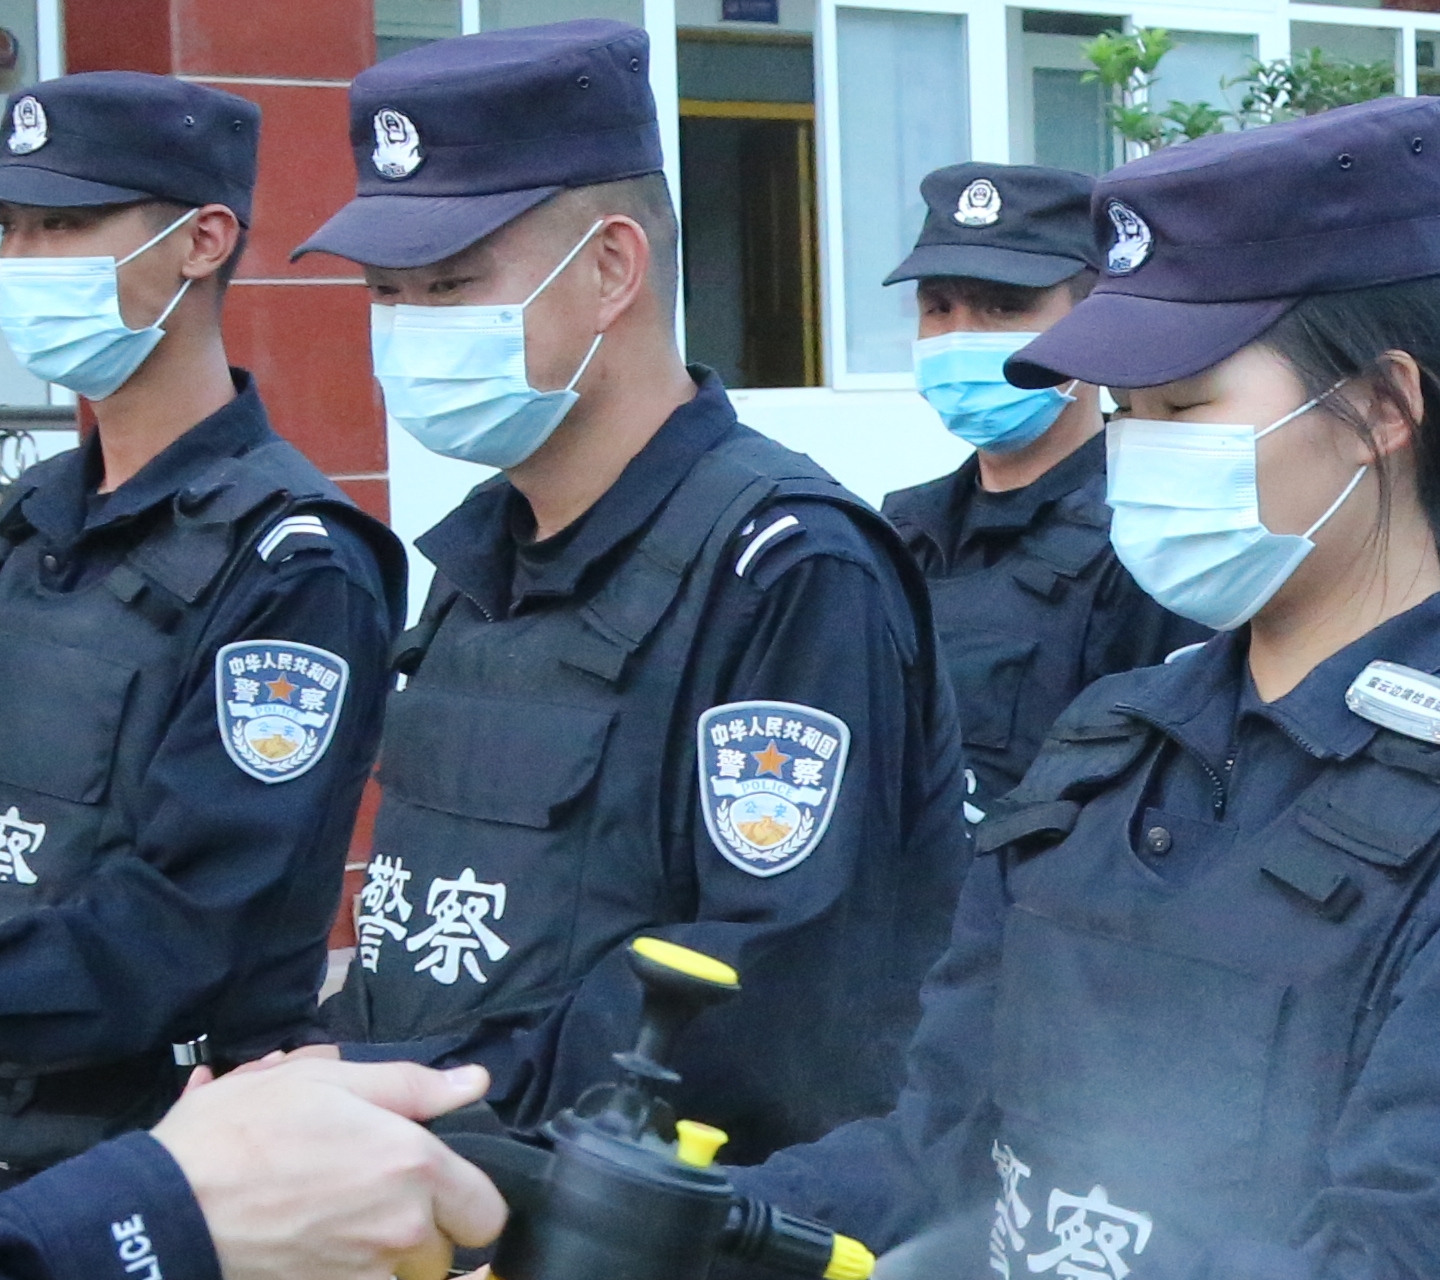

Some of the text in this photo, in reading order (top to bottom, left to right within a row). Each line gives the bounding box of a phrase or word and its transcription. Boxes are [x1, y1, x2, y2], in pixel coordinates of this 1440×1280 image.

[228, 651, 340, 691] 中华人民共和国
[710, 716, 839, 761] 中华人民共和国
[741, 780, 794, 798] POLICE
[357, 853, 511, 985] 警察
